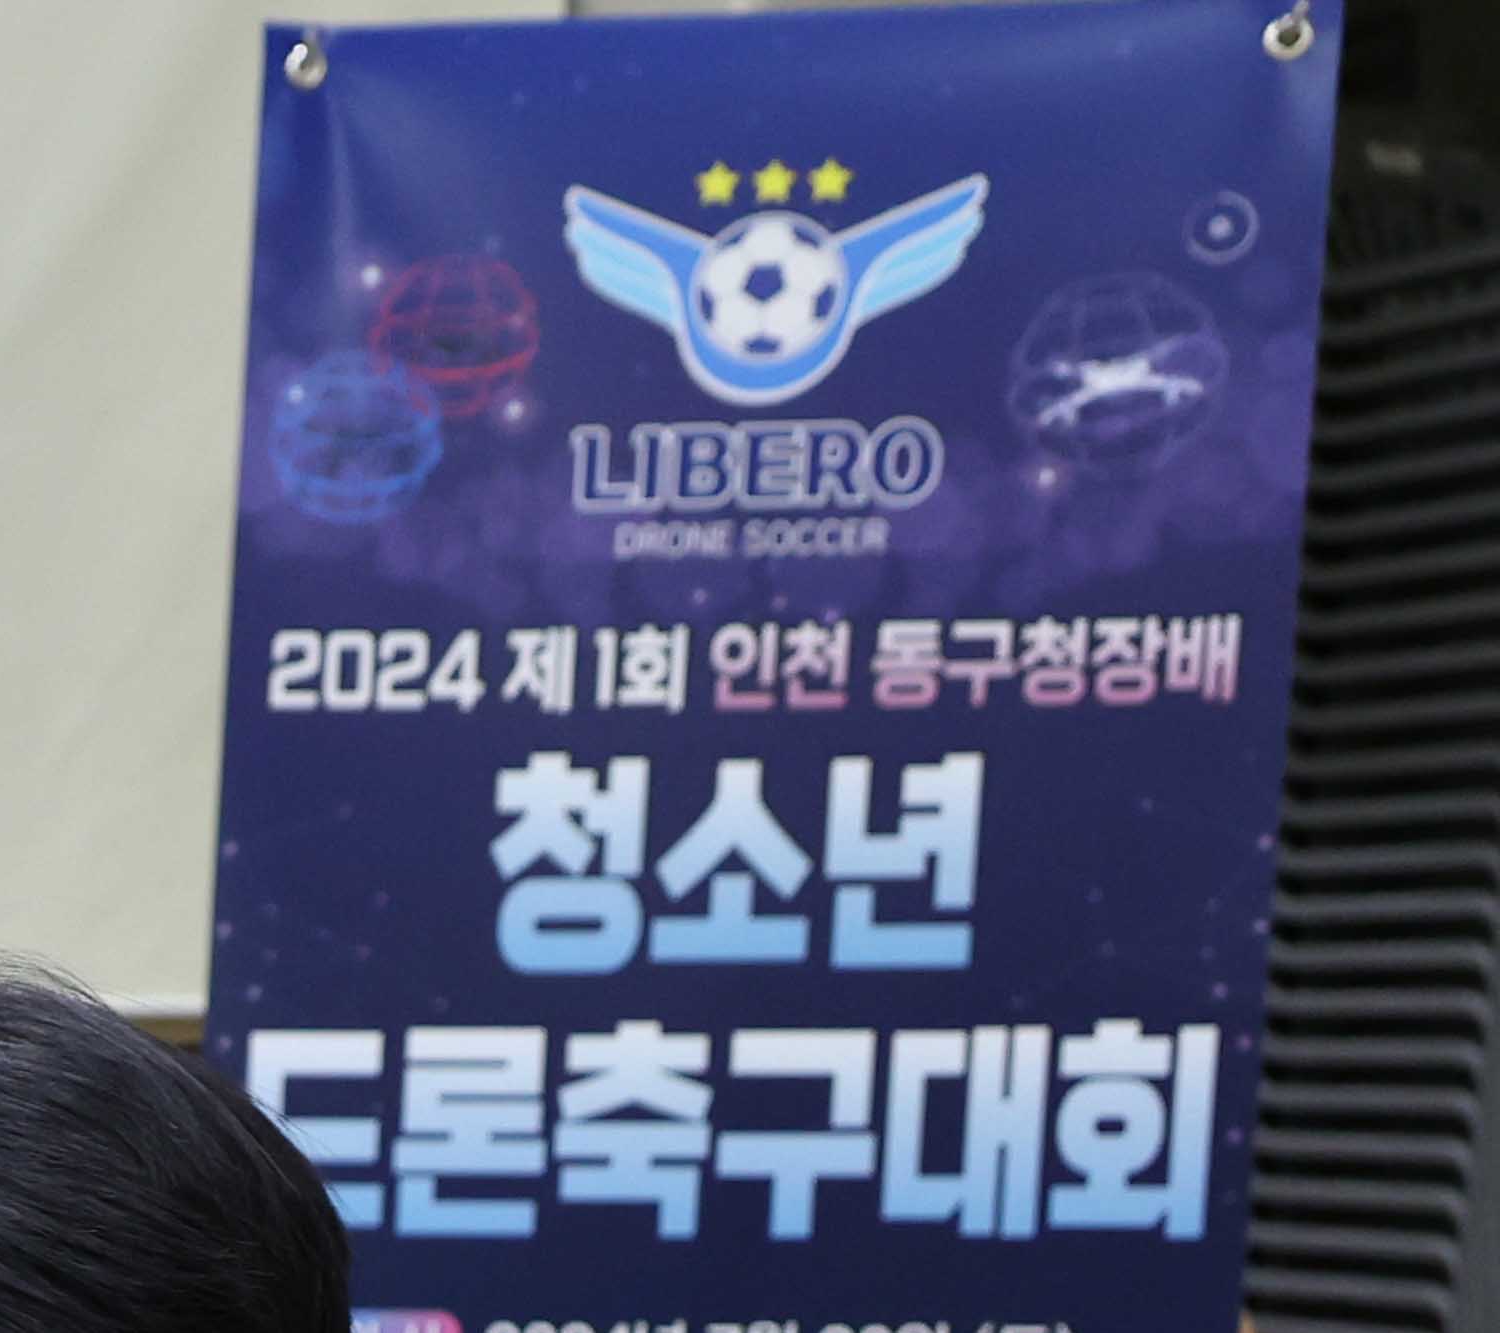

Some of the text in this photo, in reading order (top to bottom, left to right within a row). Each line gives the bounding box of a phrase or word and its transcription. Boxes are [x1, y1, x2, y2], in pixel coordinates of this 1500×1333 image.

[569, 415, 945, 513] LIBERO
[613, 517, 889, 559] DRONE SOCCER
[267, 614, 1244, 714] 2024 제 1회 인천 동구청장배
[491, 752, 983, 974] 청소년
[245, 1018, 1222, 1242] 드론축구대회
